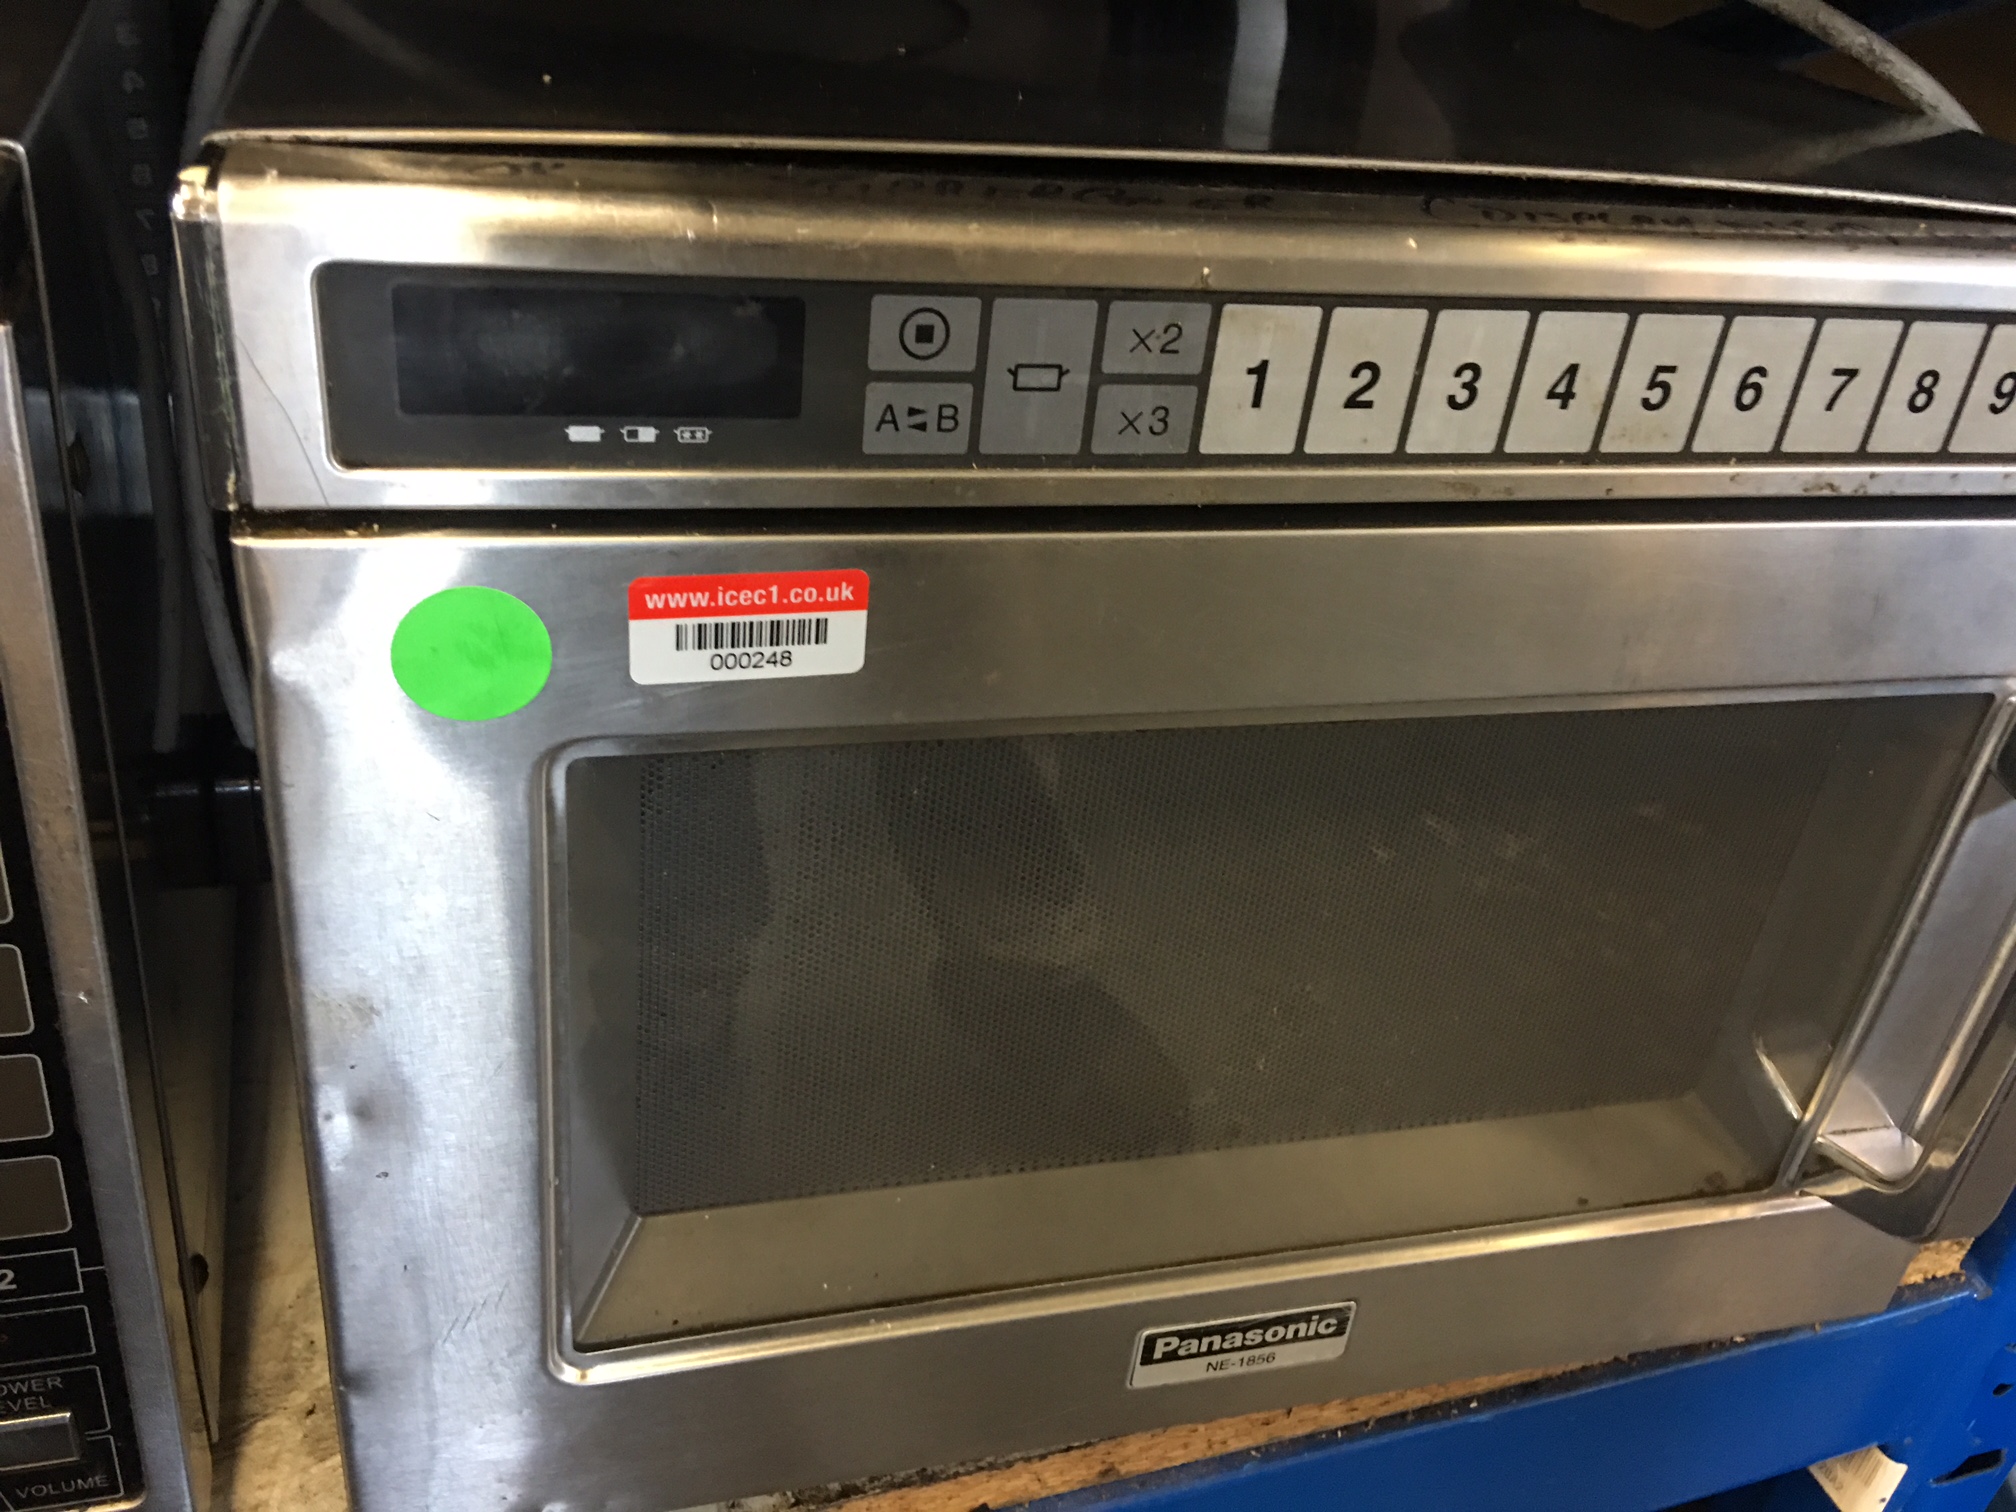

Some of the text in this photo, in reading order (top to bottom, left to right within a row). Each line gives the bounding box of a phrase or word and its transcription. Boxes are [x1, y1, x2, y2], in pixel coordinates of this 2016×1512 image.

[1246, 359, 2016, 415] 1 2 3 4 5 6 7 8 9
[875, 403, 959, 433] A B
[645, 581, 855, 610] www.icec1.co.uk
[710, 650, 793, 671] 000248
[1153, 1315, 1338, 1360] Panasonic
[1206, 1352, 1277, 1373] NE-1856
[16, 1474, 110, 1499] VOLUME
